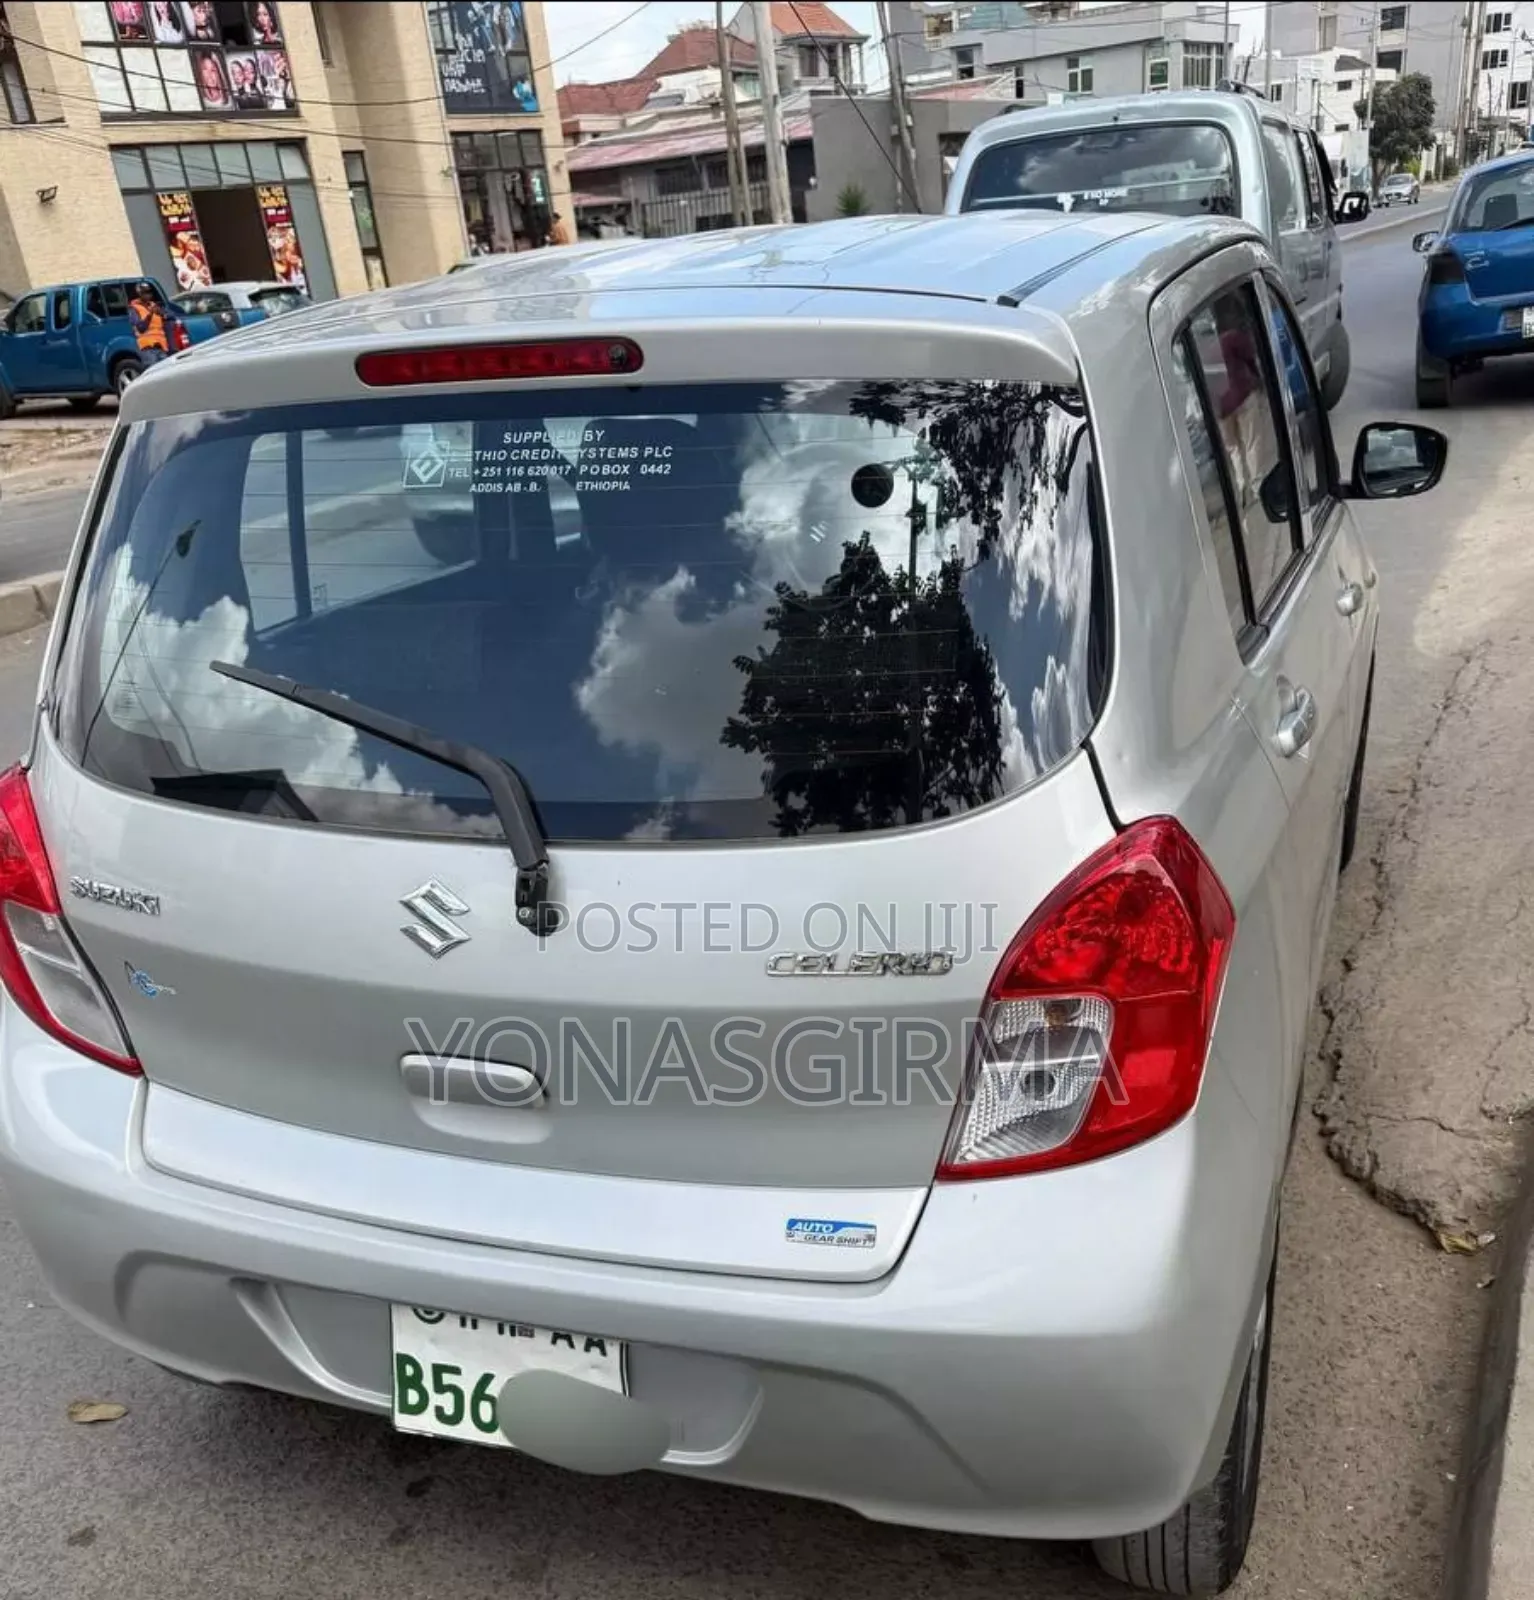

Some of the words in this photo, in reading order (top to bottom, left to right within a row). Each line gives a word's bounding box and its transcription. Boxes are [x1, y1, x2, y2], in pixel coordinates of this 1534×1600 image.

[584, 430, 605, 442] BY
[570, 447, 639, 459] YSTEMS
[644, 446, 673, 458] PLC
[448, 467, 470, 478] TEL
[506, 465, 525, 477] 116
[640, 463, 672, 475] 0442
[469, 483, 503, 493] ADDIS
[576, 481, 631, 491] ETHIOPIA
[70, 876, 161, 916] SUZUKI
[766, 951, 954, 978] CELERIO
[791, 1221, 834, 1233] AUTO
[804, 1233, 835, 1242] GEAR
[836, 1235, 868, 1245] SHIFT
